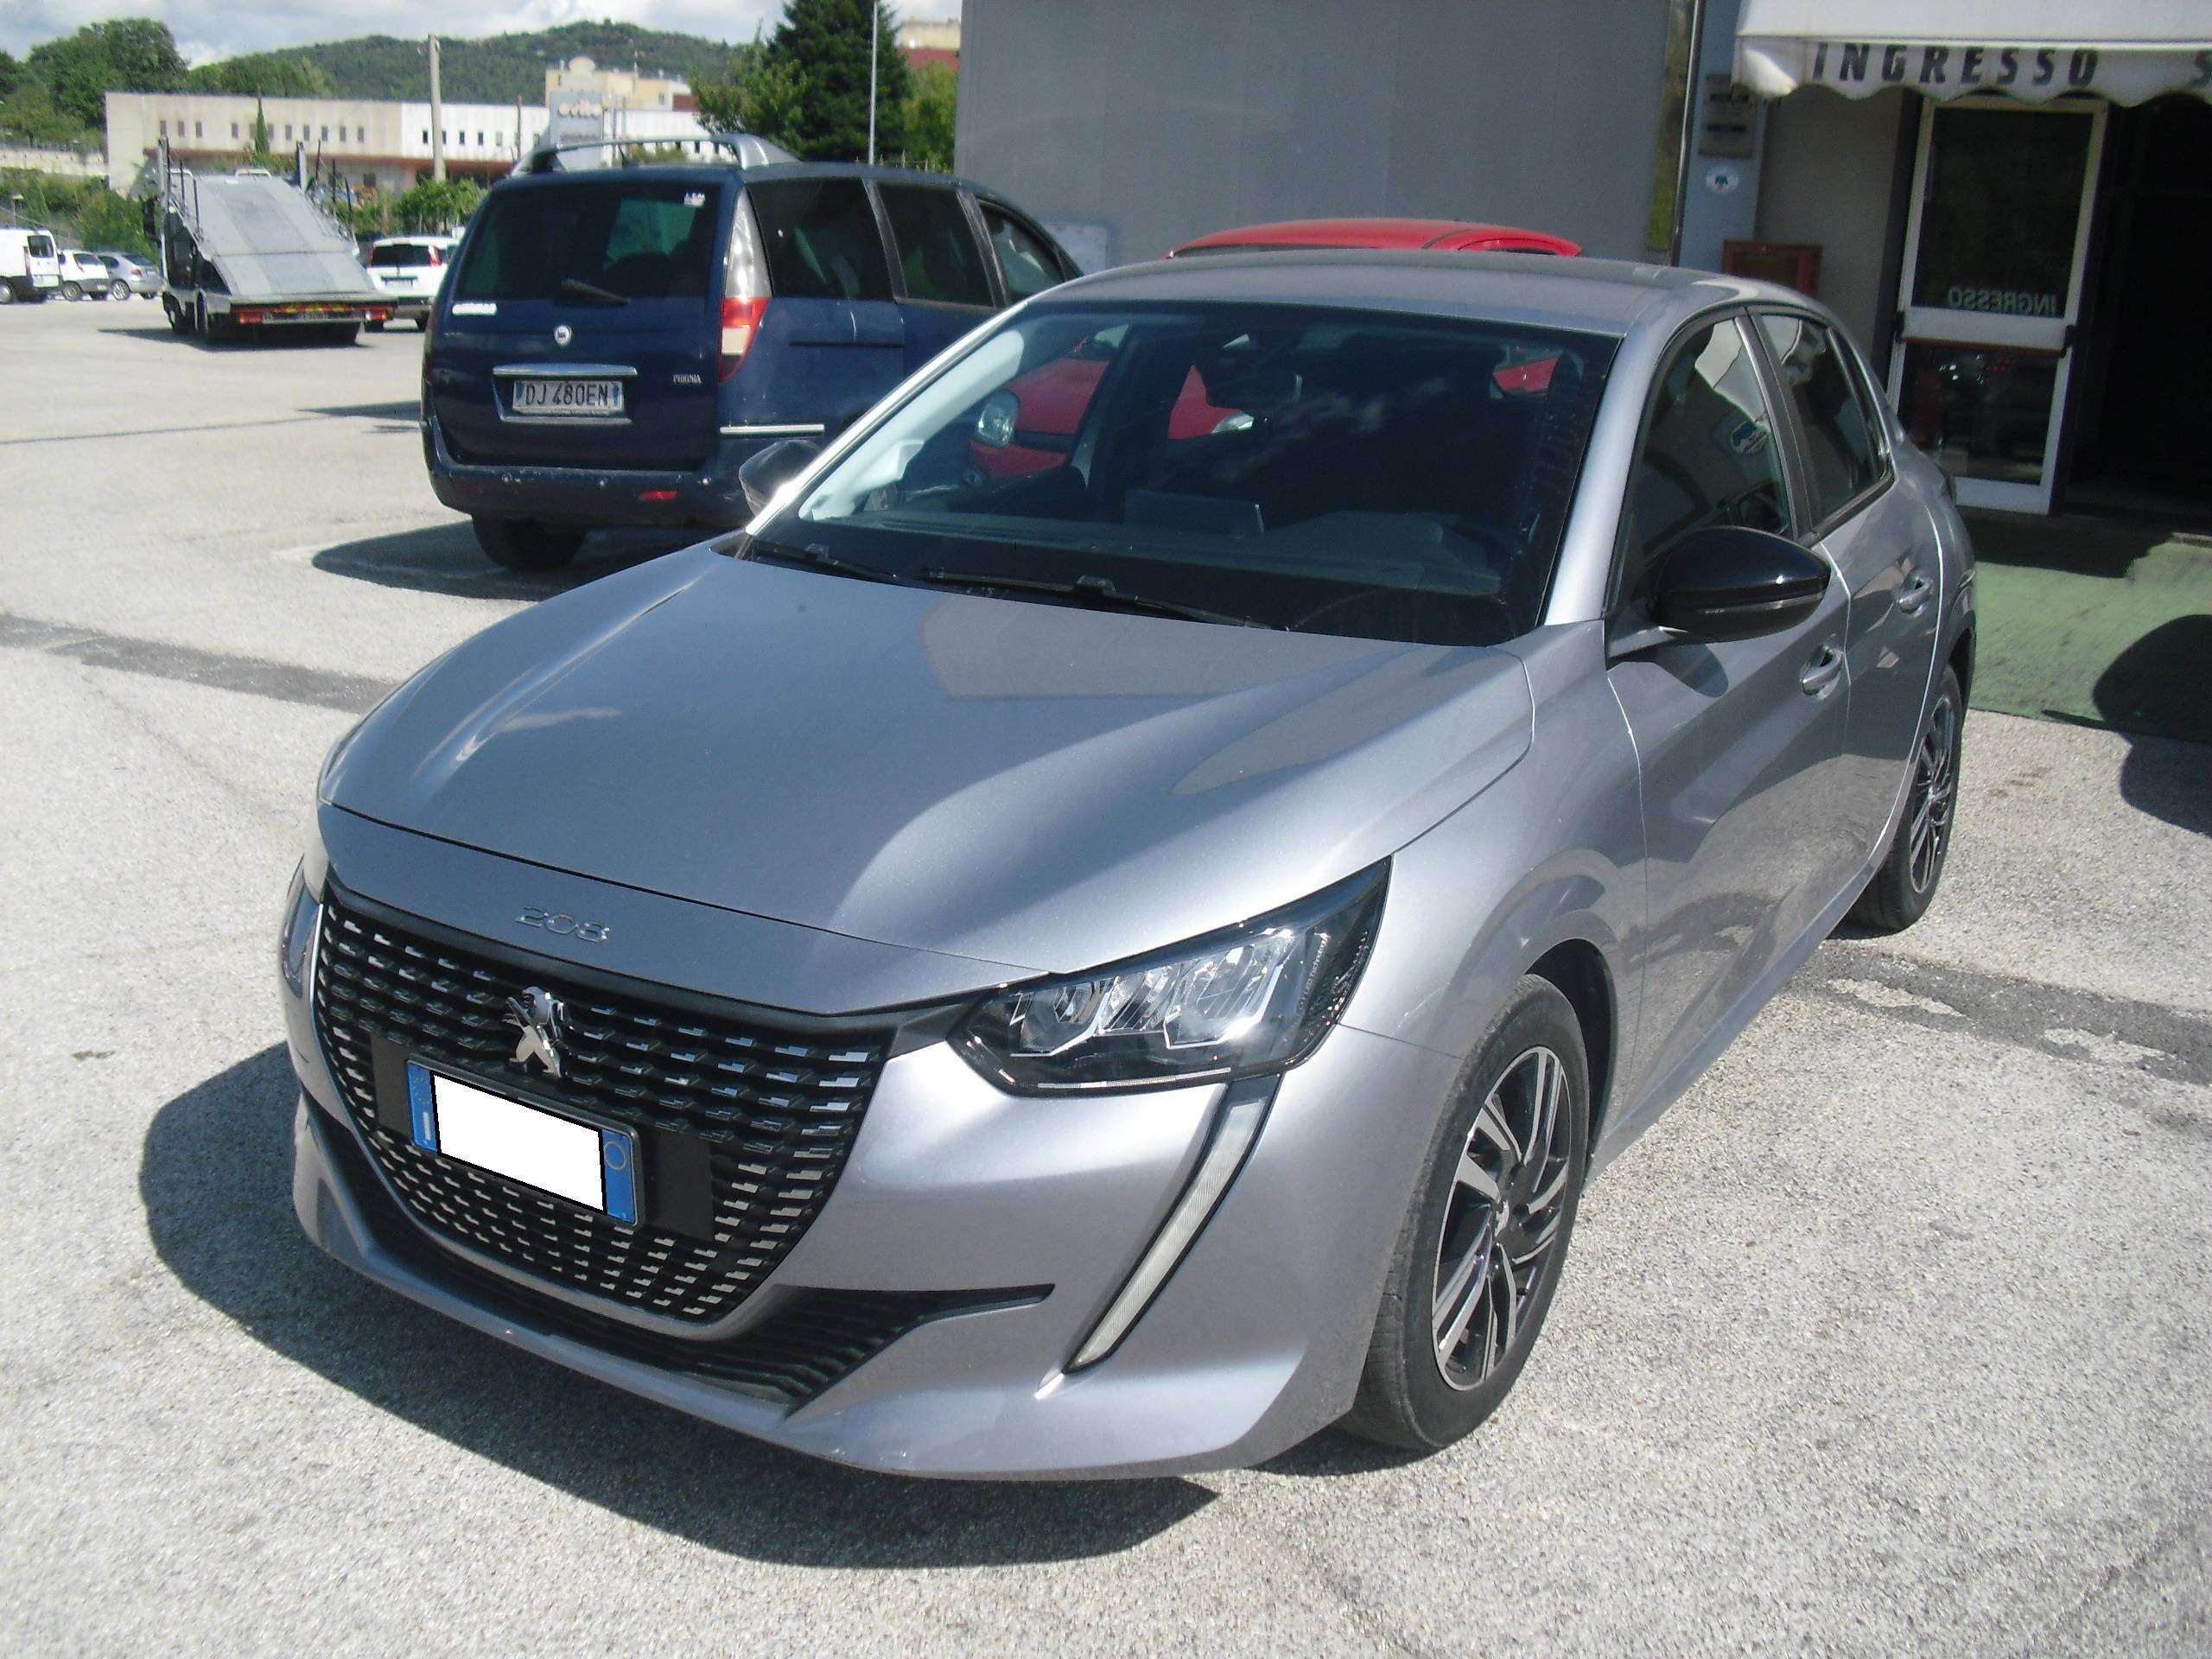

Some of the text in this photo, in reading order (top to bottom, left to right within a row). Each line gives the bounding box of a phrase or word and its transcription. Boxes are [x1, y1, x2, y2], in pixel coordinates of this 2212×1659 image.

[1813, 43, 2100, 86] INGRESSO
[525, 384, 608, 406] DJ 480EN
[516, 906, 610, 944] 208
